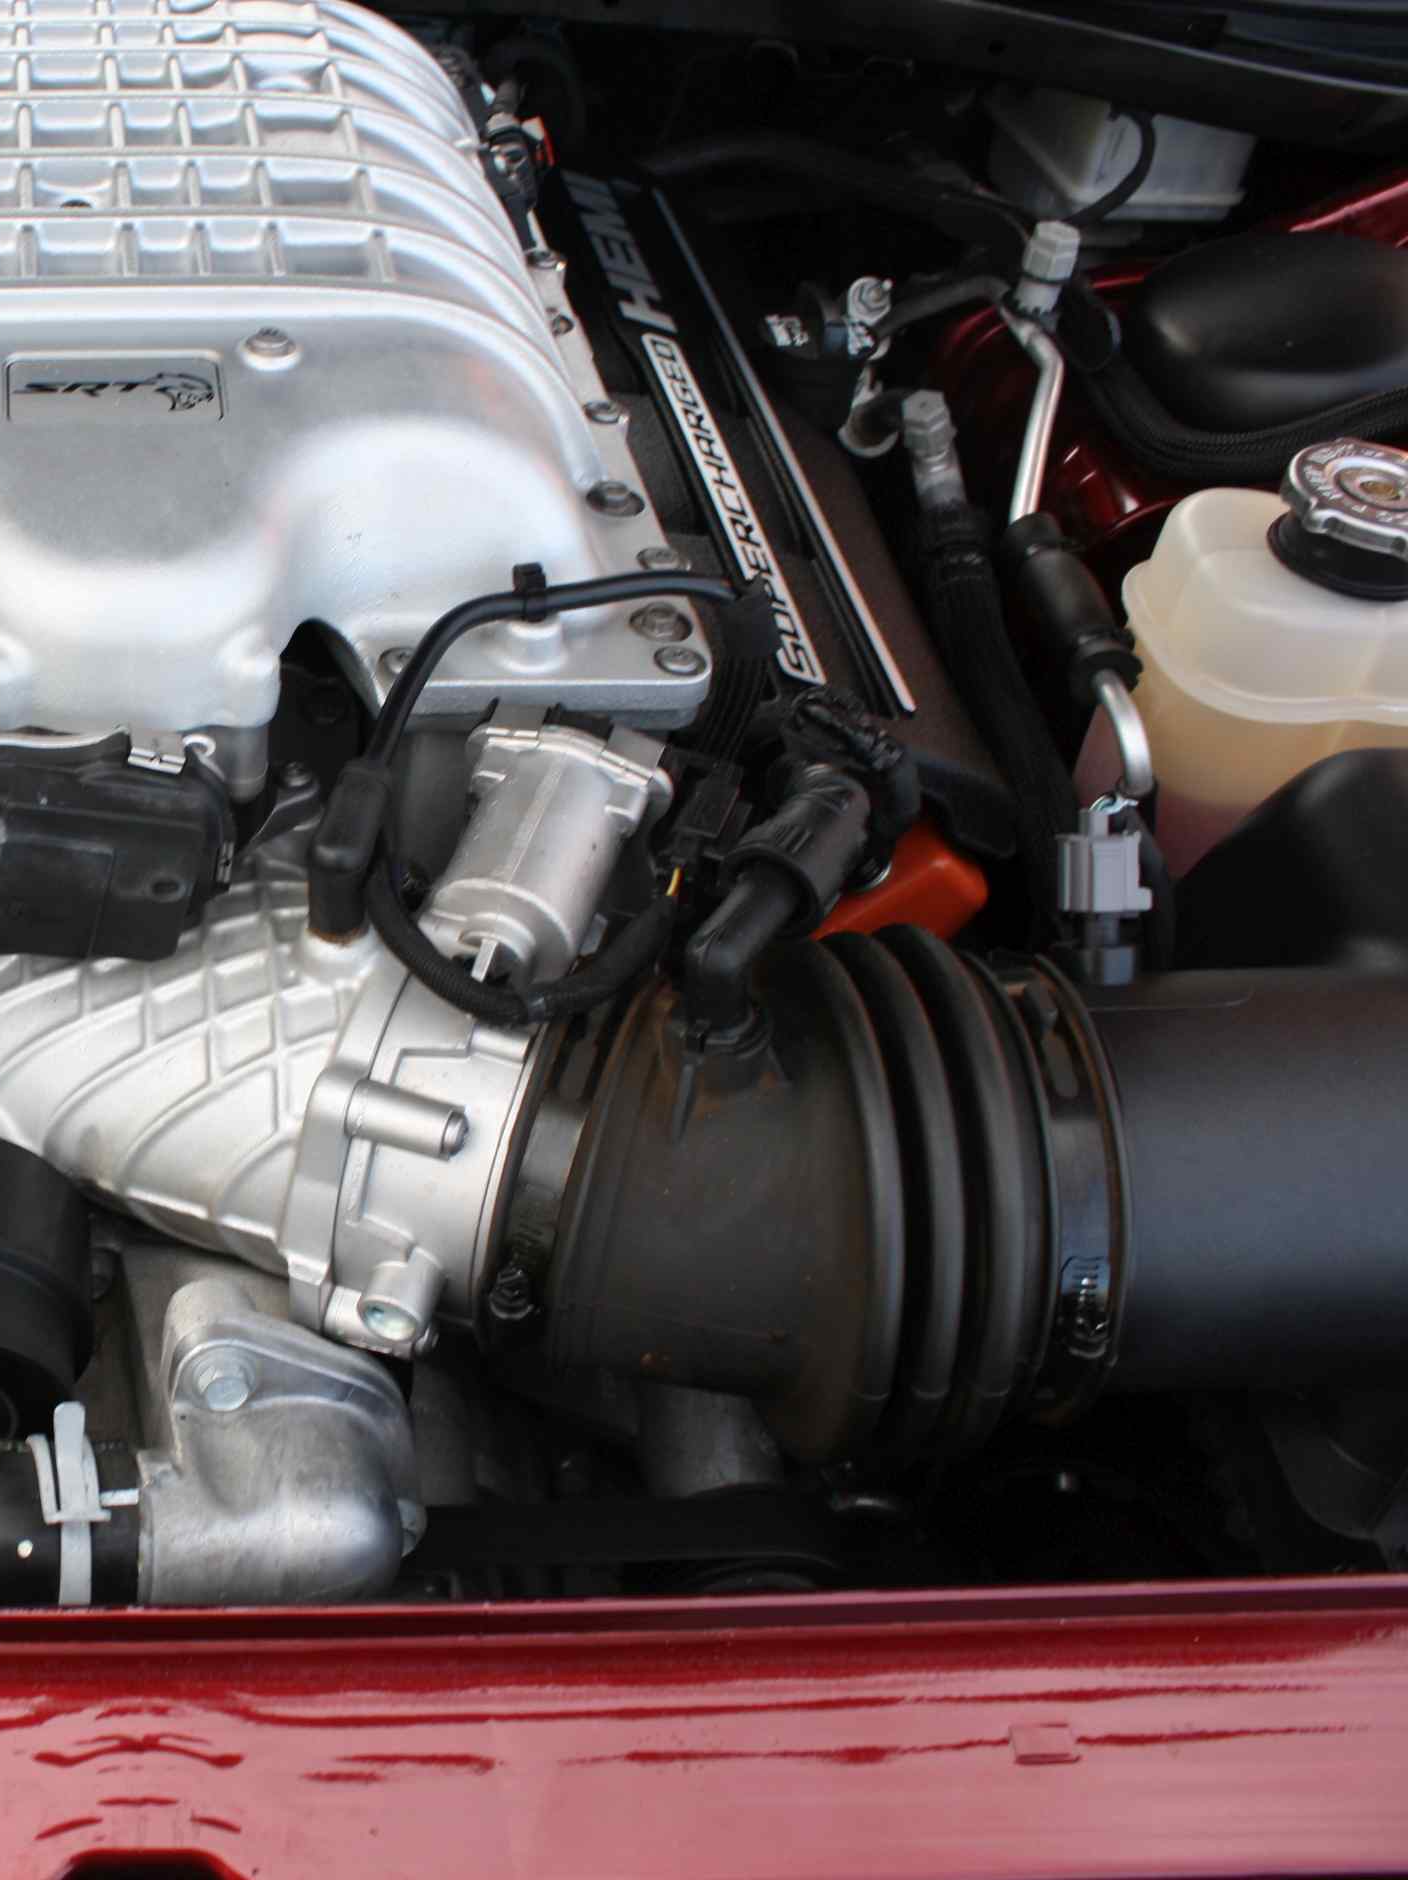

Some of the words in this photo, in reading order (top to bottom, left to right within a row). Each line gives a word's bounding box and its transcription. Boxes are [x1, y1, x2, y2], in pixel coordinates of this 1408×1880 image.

[559, 169, 678, 334] HEMI
[13, 381, 155, 398] SRT
[648, 338, 819, 681] SUPERCHARGED
